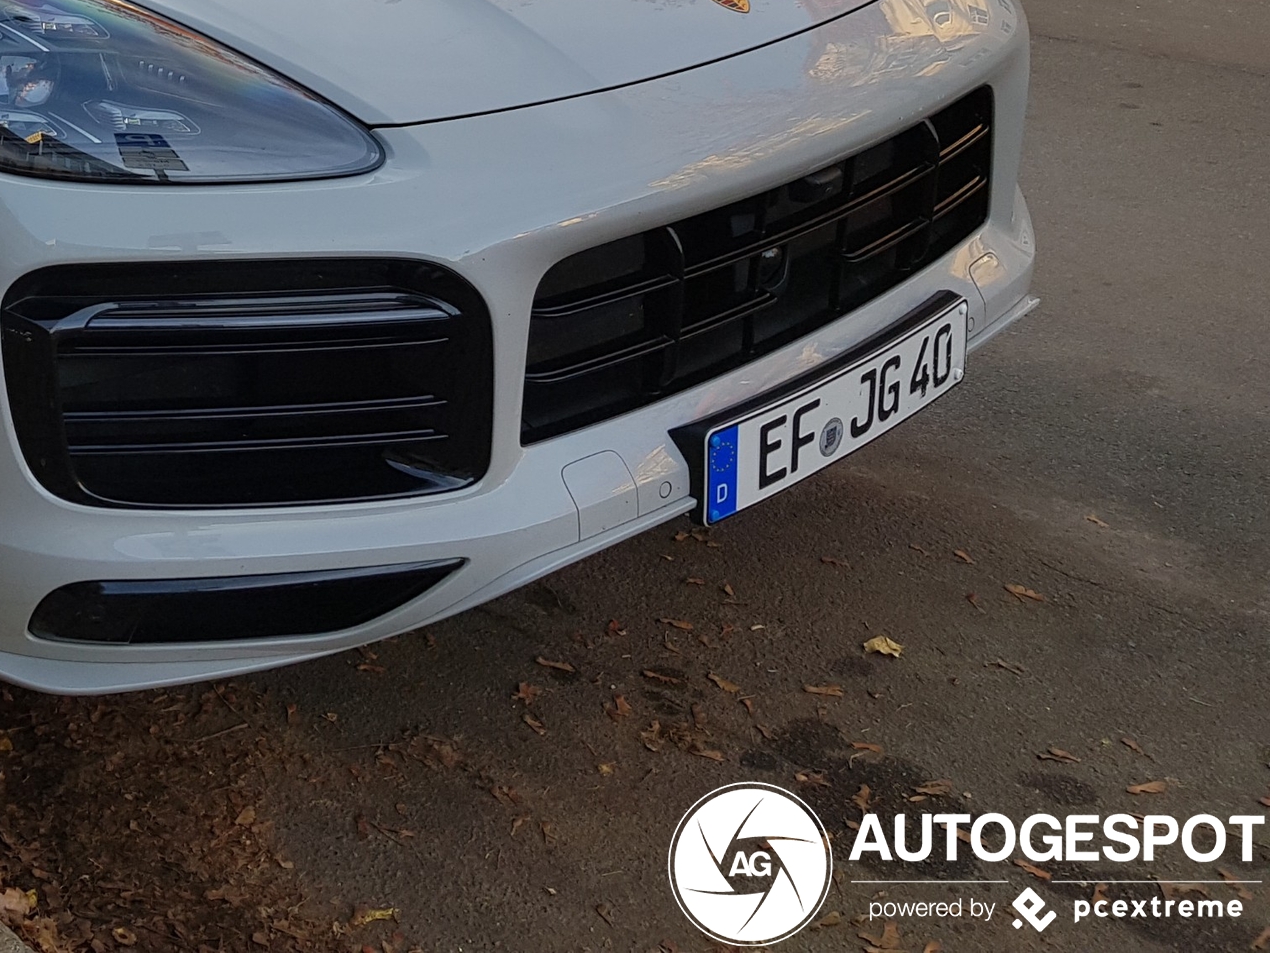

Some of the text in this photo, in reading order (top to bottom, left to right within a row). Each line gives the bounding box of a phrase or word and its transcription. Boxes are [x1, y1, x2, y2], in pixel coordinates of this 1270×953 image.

[759, 398, 821, 489] EF
[850, 355, 901, 438] JG
[910, 323, 952, 398] 40
[717, 483, 728, 503] D
